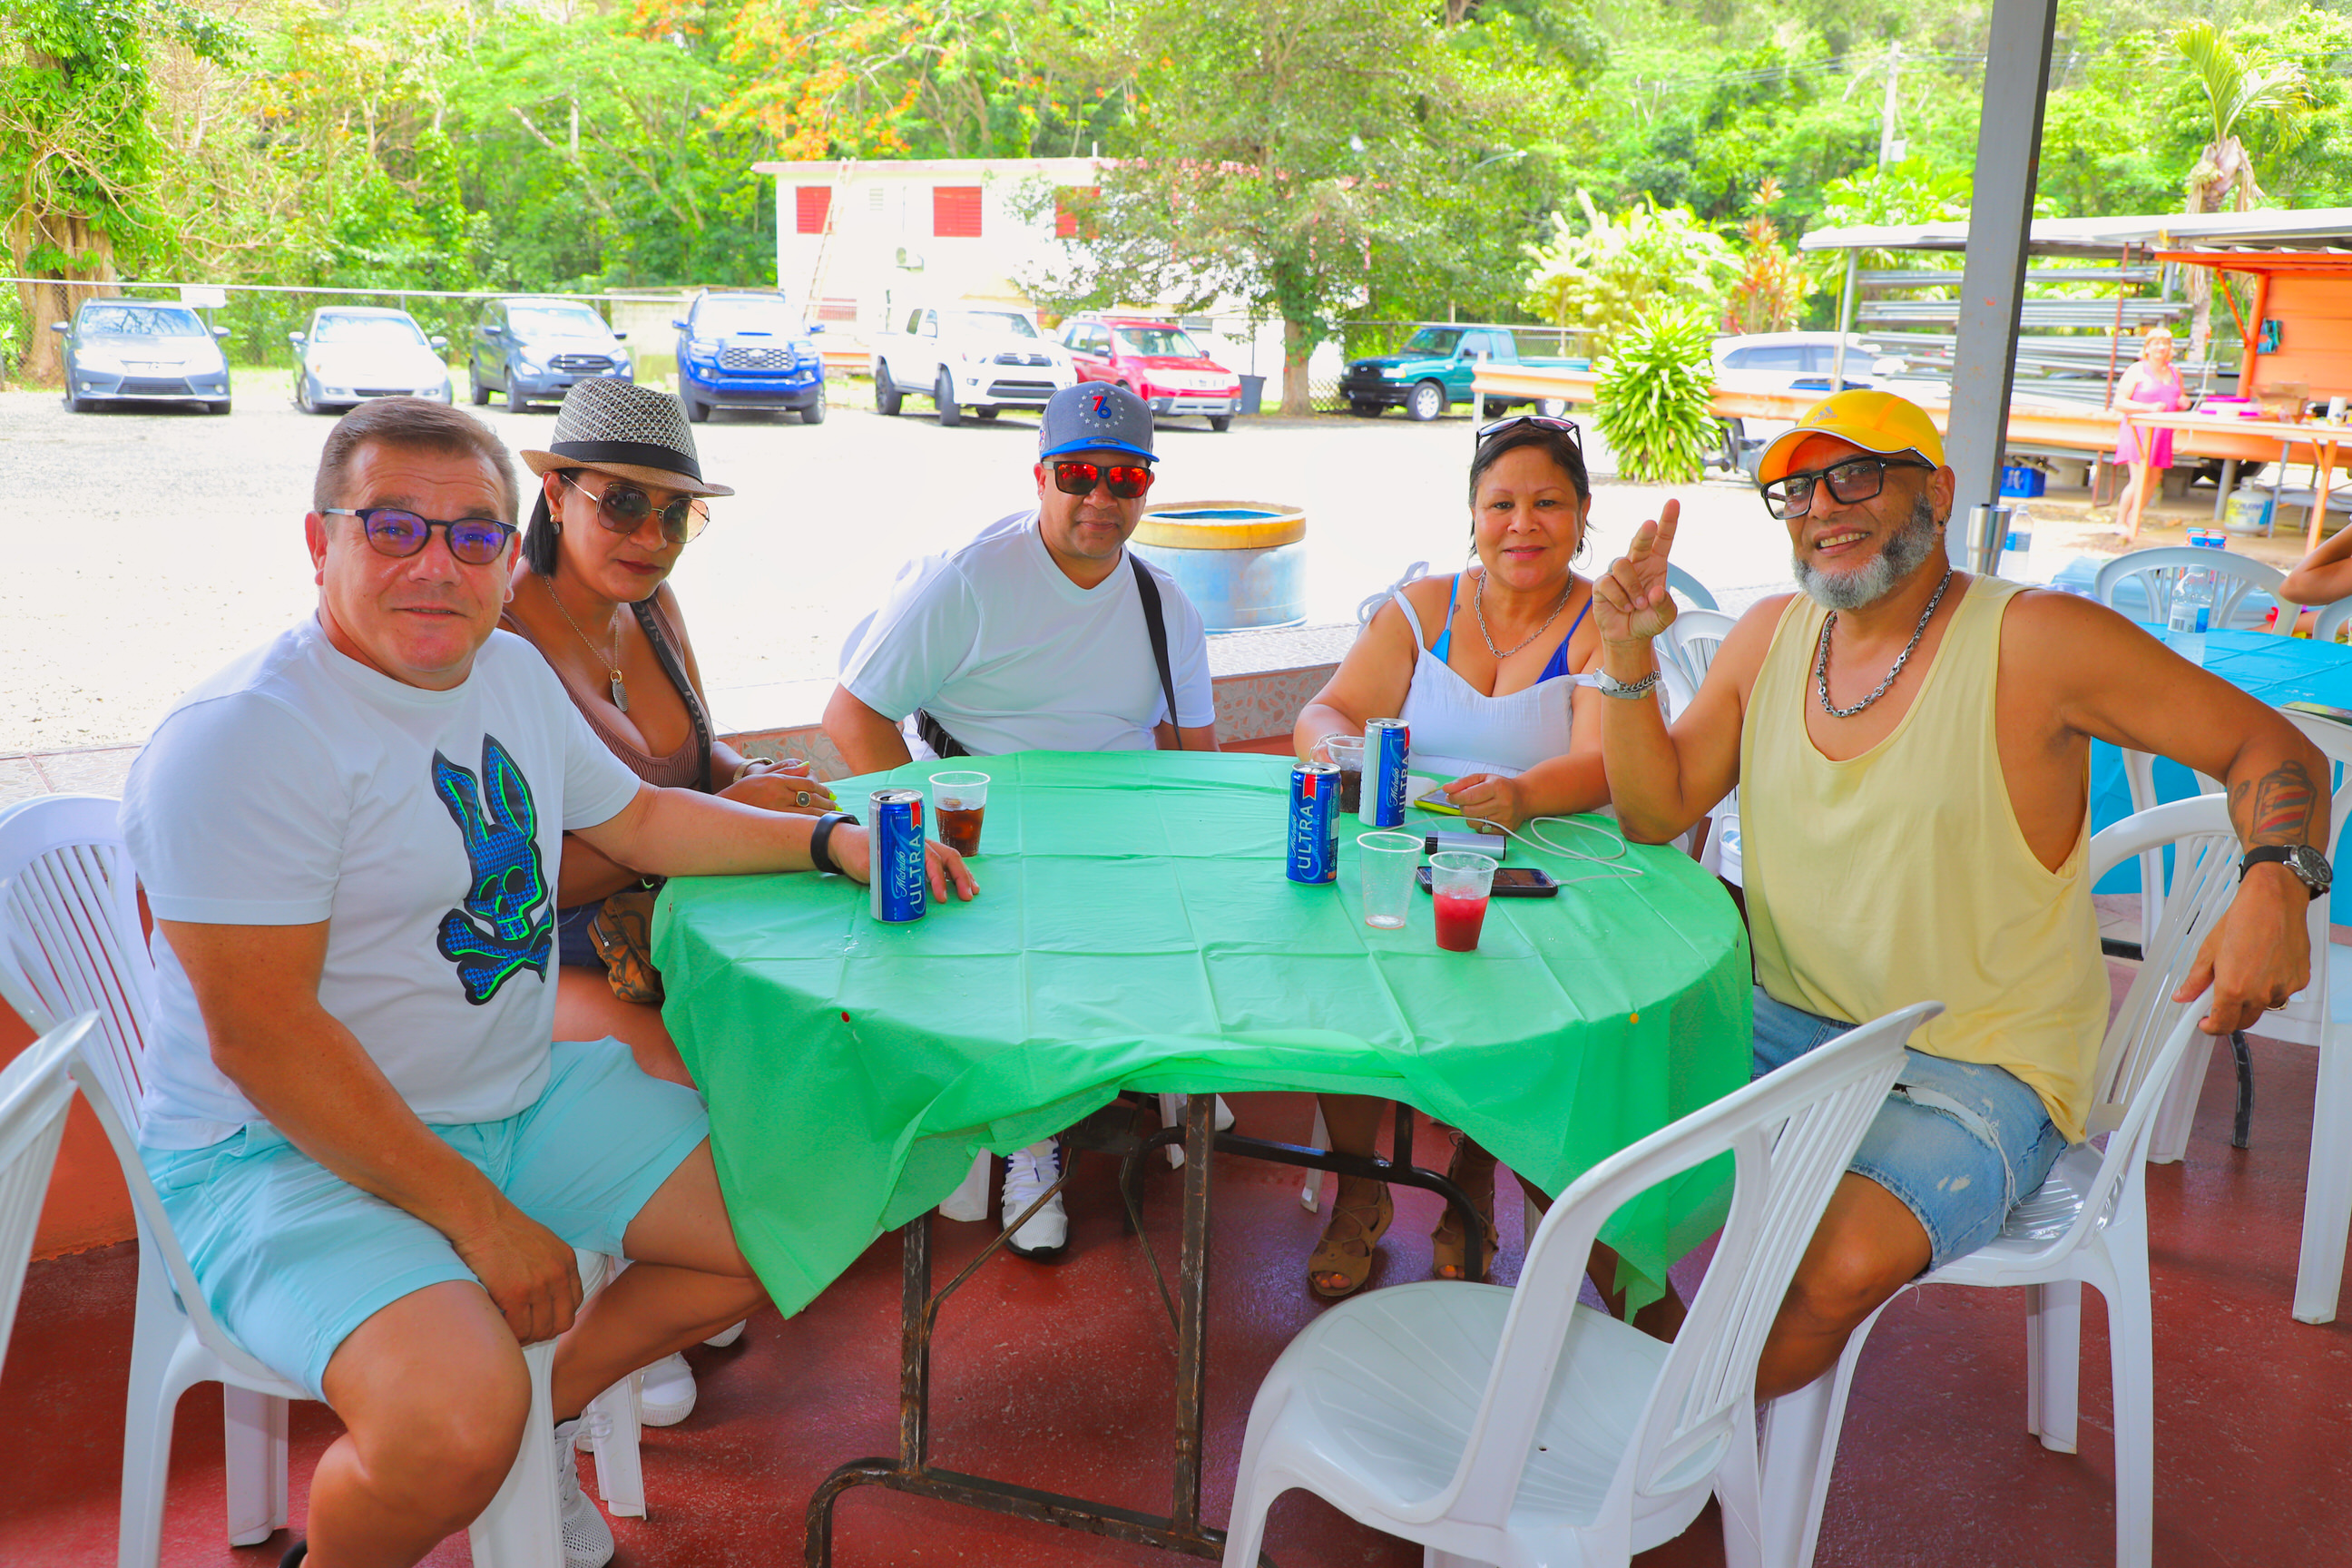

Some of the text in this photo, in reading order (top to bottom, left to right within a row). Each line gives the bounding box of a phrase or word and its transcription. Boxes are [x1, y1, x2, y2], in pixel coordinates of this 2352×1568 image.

[1092, 396, 1112, 418] 76
[1297, 804, 1314, 869] ULTRA
[895, 850, 907, 898] Michelob
[909, 834, 923, 906] ULTRA
